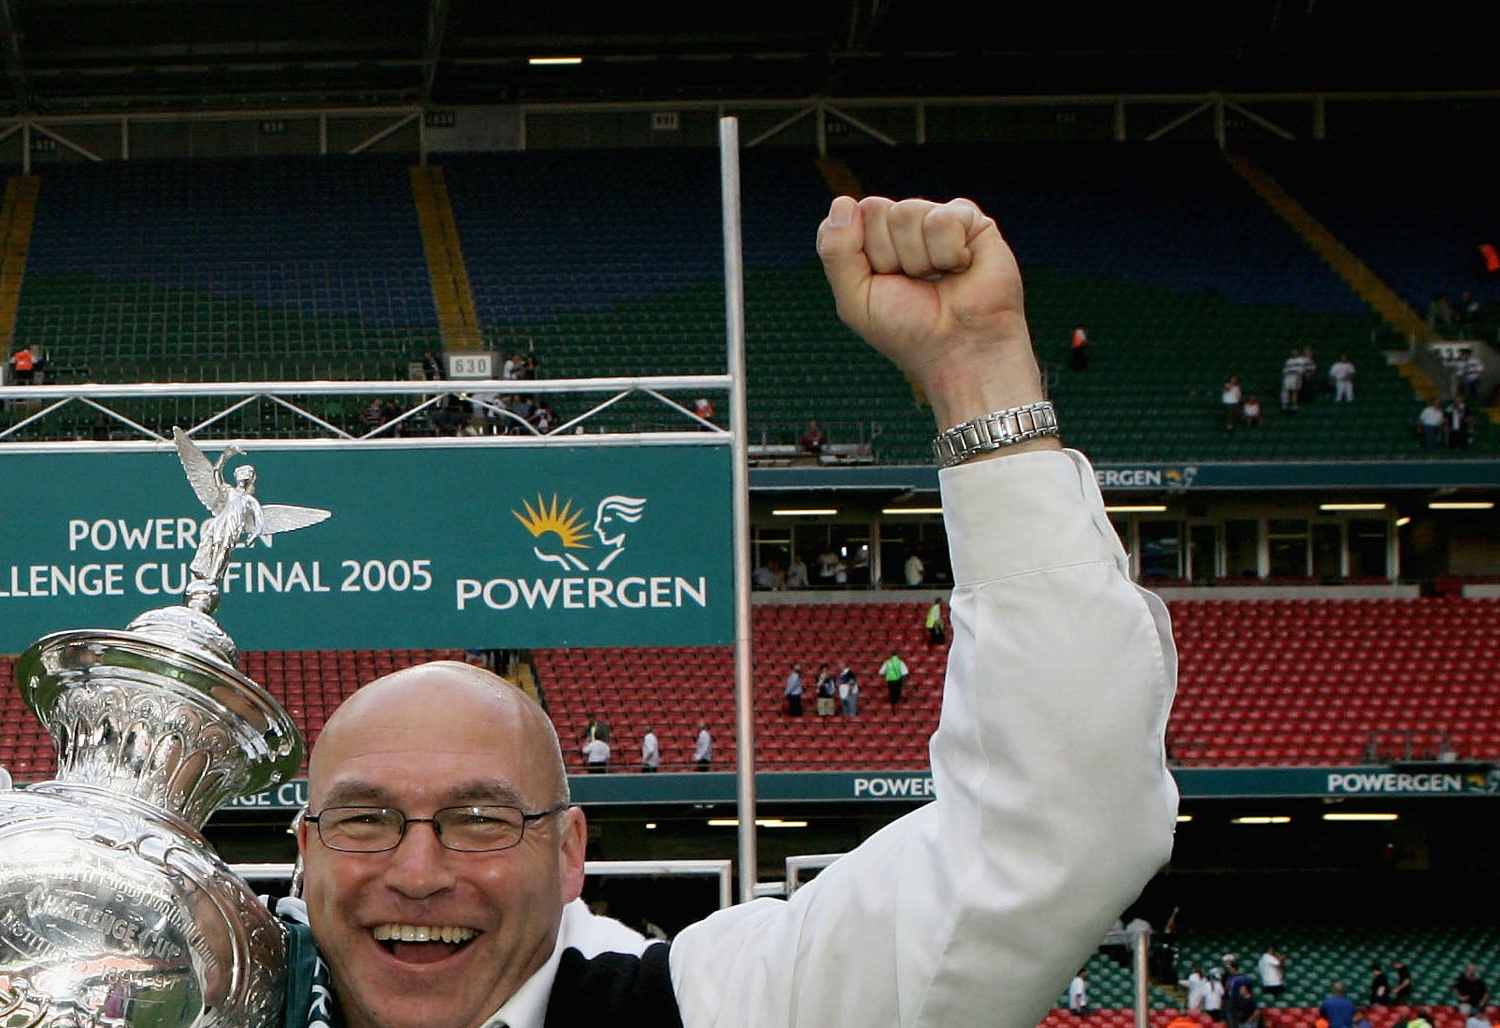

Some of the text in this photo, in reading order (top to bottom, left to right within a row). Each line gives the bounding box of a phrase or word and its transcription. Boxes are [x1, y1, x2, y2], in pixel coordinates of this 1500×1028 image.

[455, 359, 488, 375] 630
[69, 518, 273, 550] POWER
[135, 562, 197, 595] CU
[227, 562, 330, 593] FINAL
[340, 560, 432, 591] 2005
[456, 576, 706, 610] POWERGEN
[1327, 775, 1462, 793] POWERGEN
